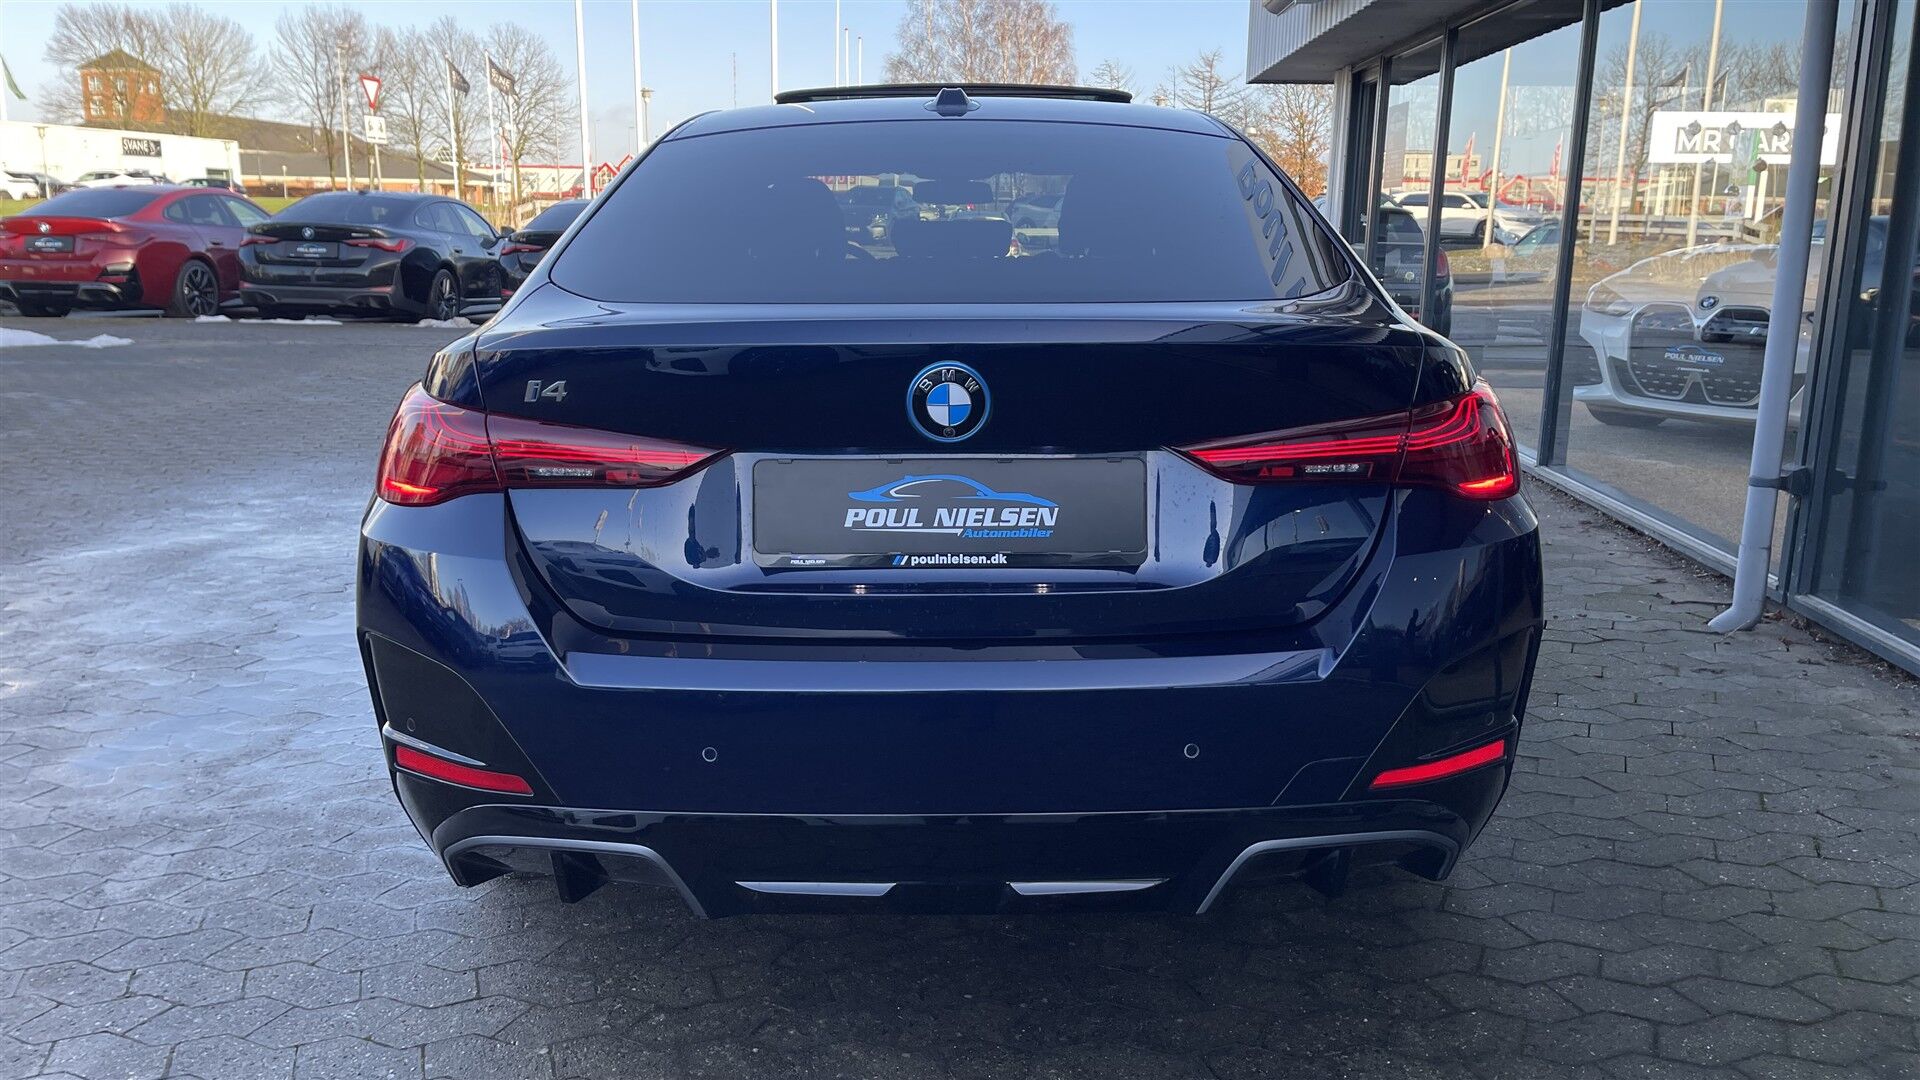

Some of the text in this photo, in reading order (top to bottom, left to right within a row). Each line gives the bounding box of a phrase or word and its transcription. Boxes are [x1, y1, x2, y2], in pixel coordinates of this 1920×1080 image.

[123, 138, 149, 152] SVANE
[1677, 129, 1721, 152] MR
[524, 380, 568, 402] i4
[919, 369, 980, 393] BMW
[844, 507, 1059, 527] POUL NIELSEN
[962, 528, 1053, 538] Automobiler
[911, 553, 1007, 566] poulnielsen.dk
